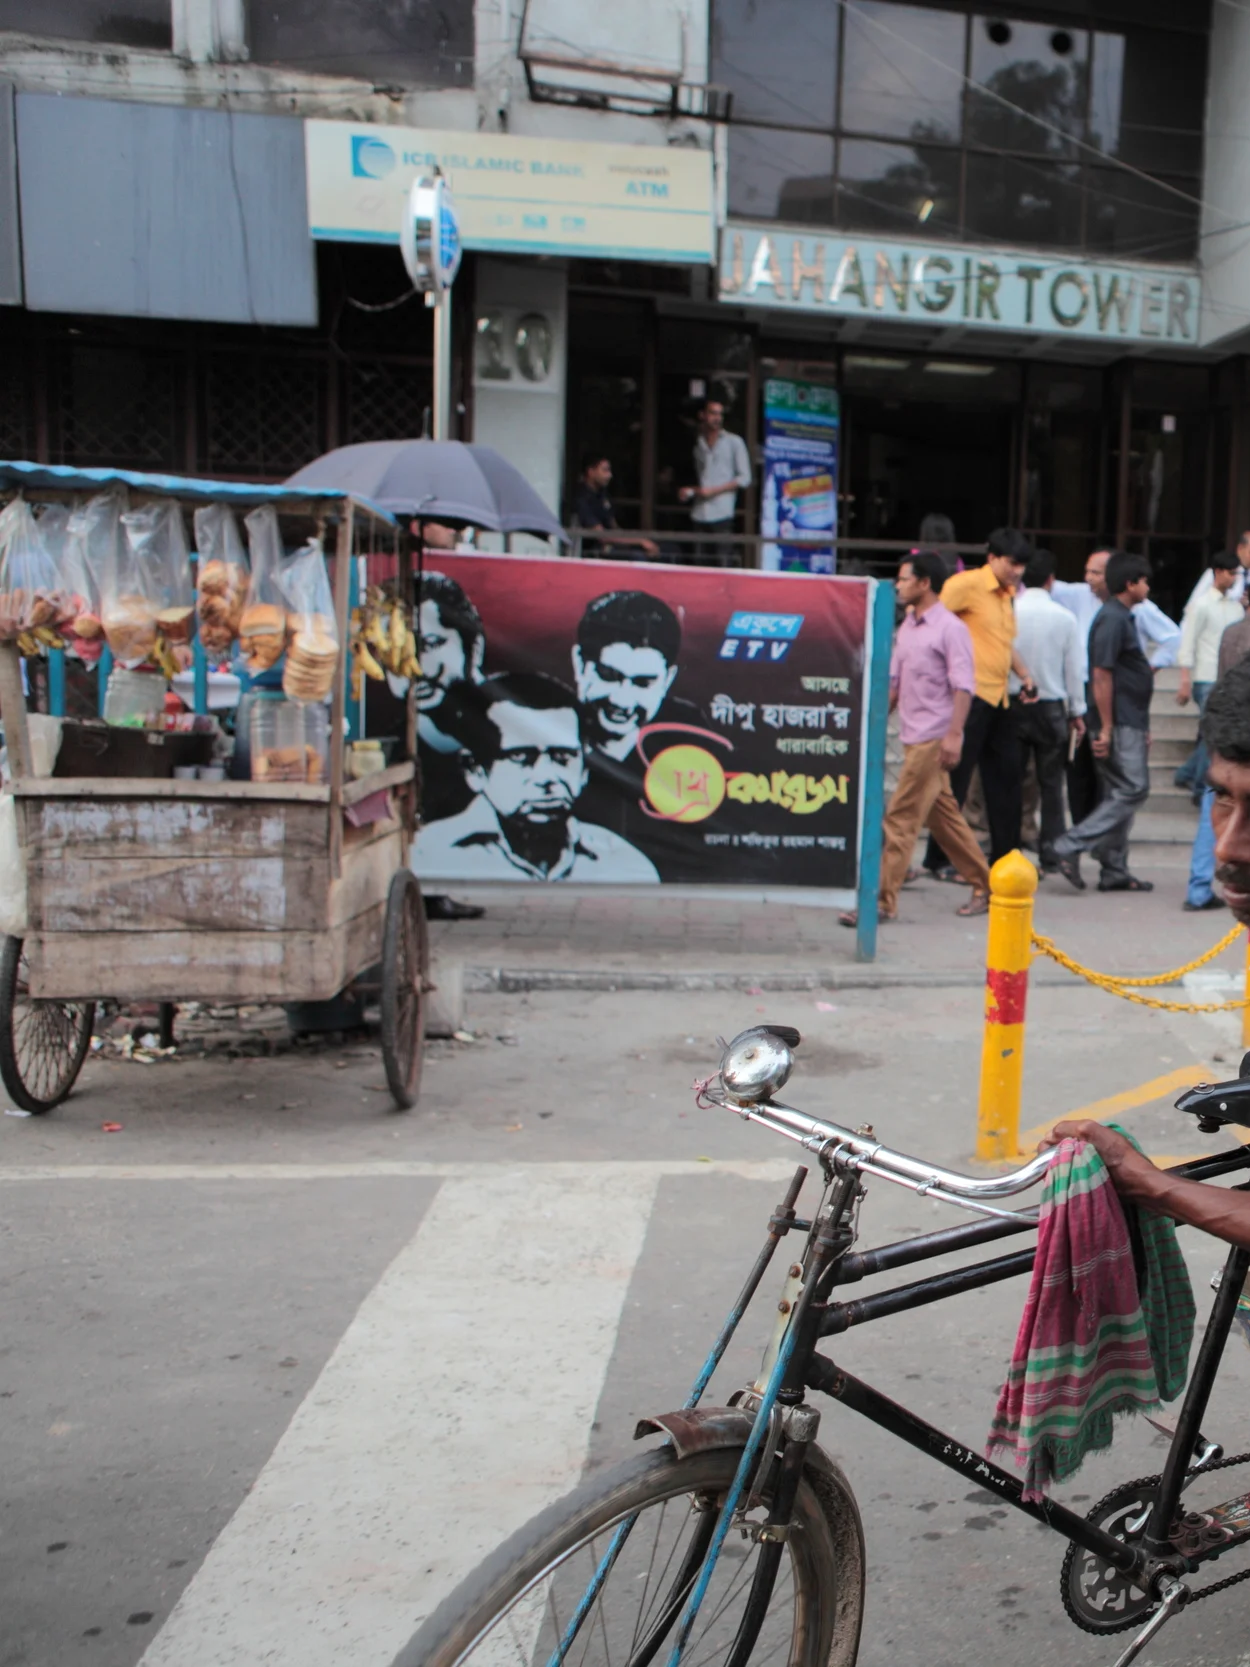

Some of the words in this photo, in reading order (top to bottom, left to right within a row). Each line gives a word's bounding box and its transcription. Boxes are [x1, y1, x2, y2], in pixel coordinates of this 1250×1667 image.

[403, 151, 438, 167] ICB
[442, 153, 525, 174] ISLAMIC
[530, 159, 586, 179] BANK
[625, 180, 670, 198] ATM
[721, 233, 1002, 321] JAHANGIR
[1017, 265, 1192, 339] TOWER
[710, 693, 756, 732] দীপু
